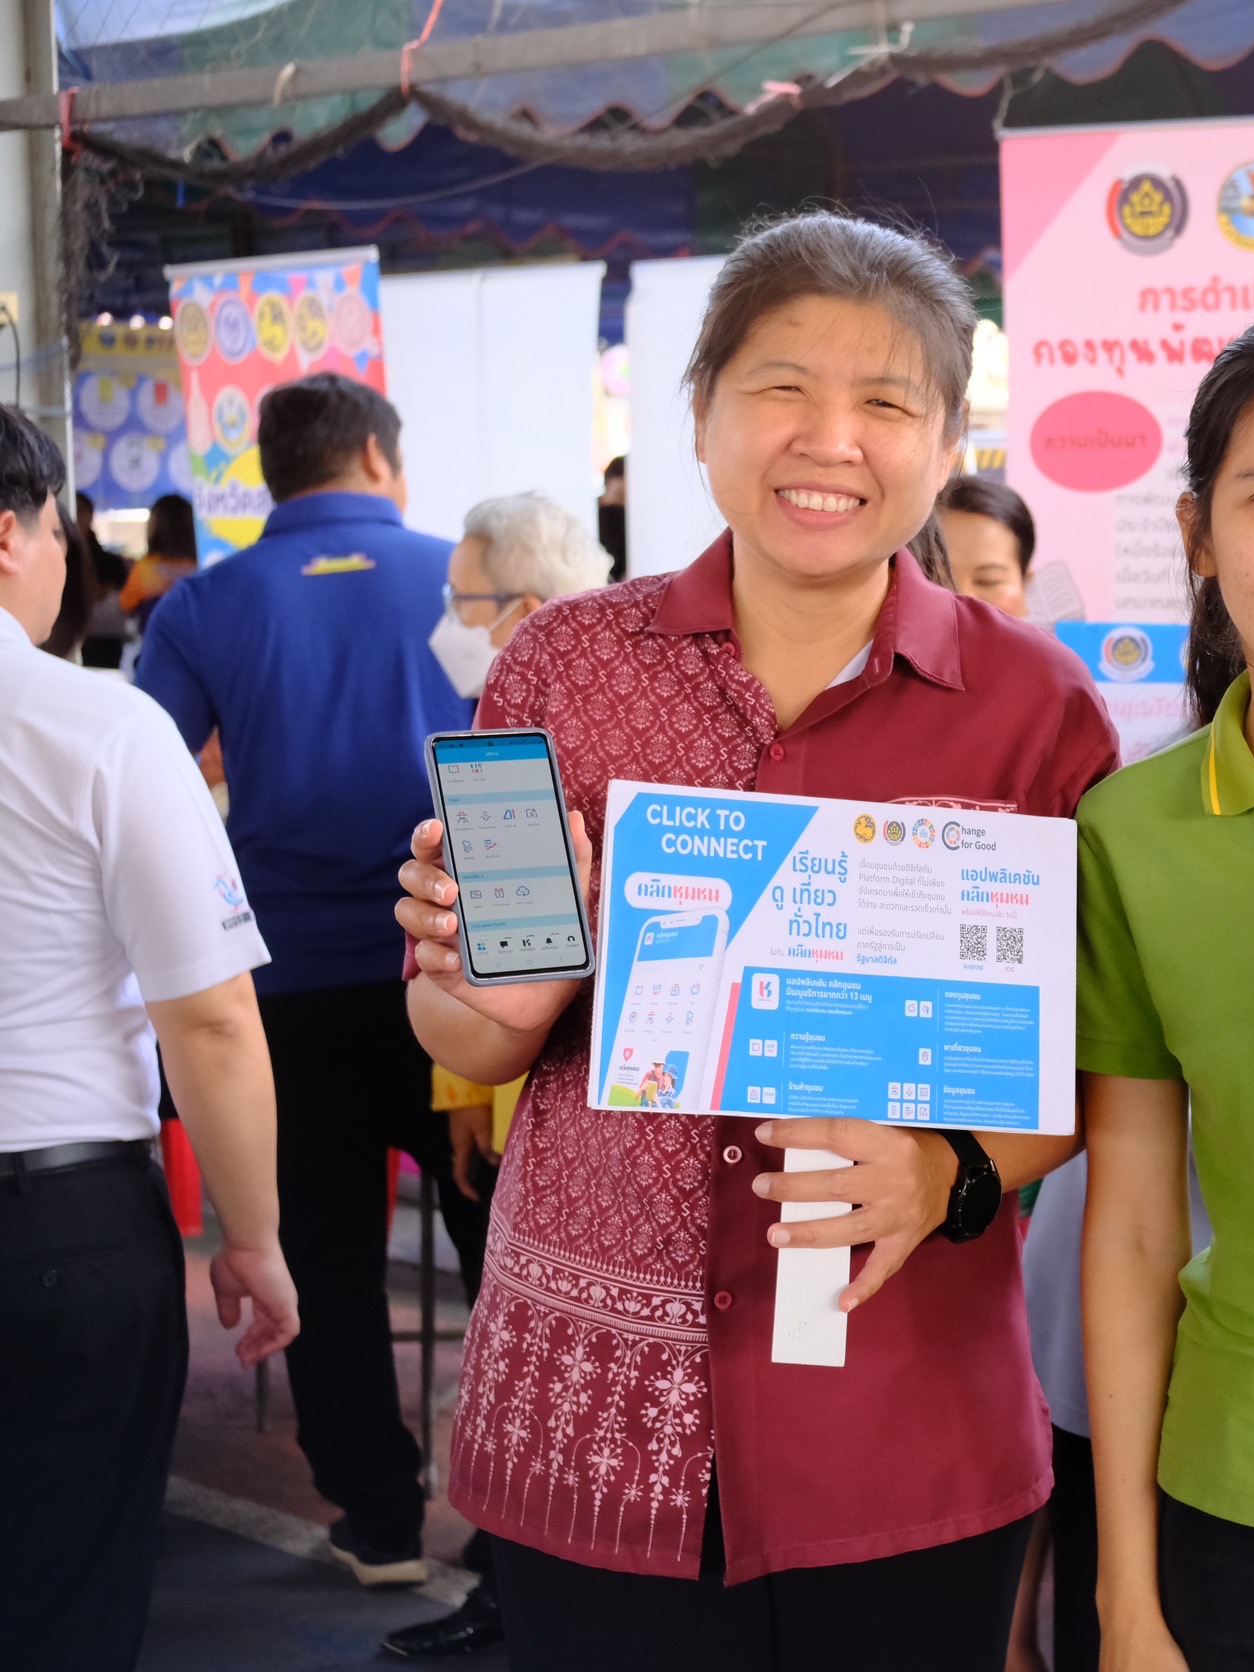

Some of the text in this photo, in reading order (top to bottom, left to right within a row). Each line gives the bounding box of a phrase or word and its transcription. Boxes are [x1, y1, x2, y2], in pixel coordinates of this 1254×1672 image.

[646, 804, 746, 832] CLICK TO
[661, 833, 768, 861] CONNECT
[961, 841, 997, 851] for Good
[792, 850, 849, 884] เรียนรู้
[961, 867, 1040, 886] แอปพลิเคชัน
[859, 873, 891, 883] Platform
[892, 875, 916, 887] Digital
[637, 878, 720, 906] คลิกชุมชน
[772, 874, 838, 911] ดู เที่ยว
[961, 885, 1029, 908] คลิกชุมชน
[858, 898, 878, 909] ได้ง่าย
[788, 906, 848, 940] ทั่วไทย
[788, 944, 845, 964] คลิกชุมชน
[856, 940, 906, 953] ภาครัฐสู่การเป็น
[856, 953, 897, 965] รัฐบาลดิจิทัล
[963, 963, 984, 971] Android
[786, 977, 827, 987] แอปพลิเคชัน
[849, 991, 859, 1001] 13
[860, 993, 873, 1004] เมนู
